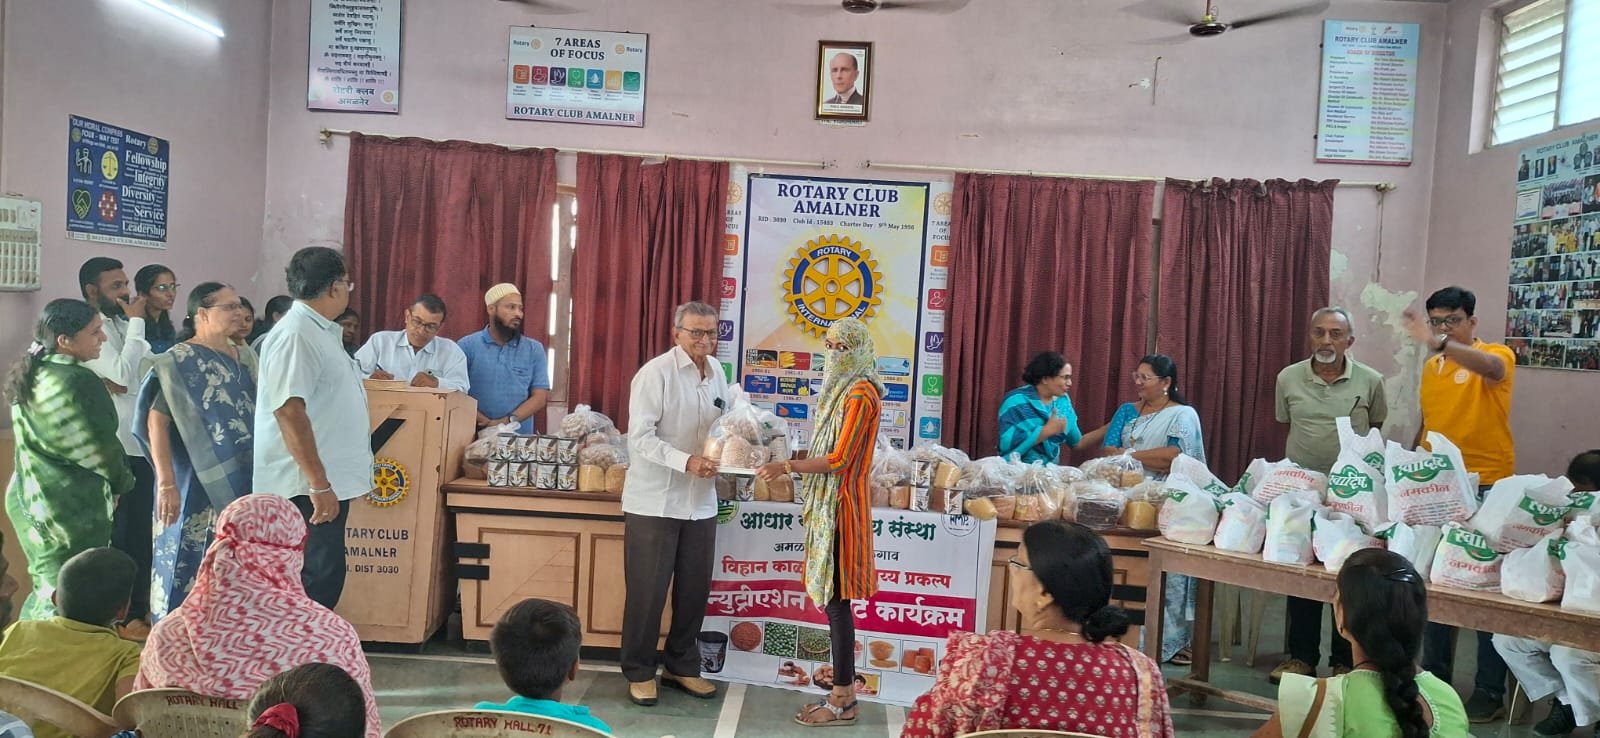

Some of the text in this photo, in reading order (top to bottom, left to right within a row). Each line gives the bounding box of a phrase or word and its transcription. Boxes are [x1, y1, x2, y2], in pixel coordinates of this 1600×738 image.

[555, 37, 601, 48] 7 AREAS
[551, 49, 605, 60] OF FOCUS
[514, 106, 635, 121] ROTARY CLUB AMALNER
[126, 134, 146, 149] Rotary
[126, 150, 167, 173] Fellowship
[135, 170, 165, 190] Integrity
[122, 185, 155, 204] Diversity
[778, 184, 899, 203] ROTARY CLUB
[134, 205, 164, 220] Service
[793, 201, 881, 217] AMALNER
[122, 220, 165, 238] Leadership
[817, 247, 852, 257] ROTARY
[1400, 484, 1450, 497] नमकीन
[740, 512, 793, 530] आधार
[888, 515, 936, 540] संस्था
[346, 528, 408, 540] TARY CLUB
[344, 547, 397, 557] AMALNER
[355, 565, 374, 573] DIST
[377, 566, 399, 574] 3030
[722, 555, 768, 576] विहान
[905, 571, 951, 589] प्रकल्प
[875, 596, 965, 628] कार्यक्रम
[167, 695, 239, 710] ROTARY HALL
[453, 716, 497, 728] ROTARY
[504, 720, 534, 732] HALL
